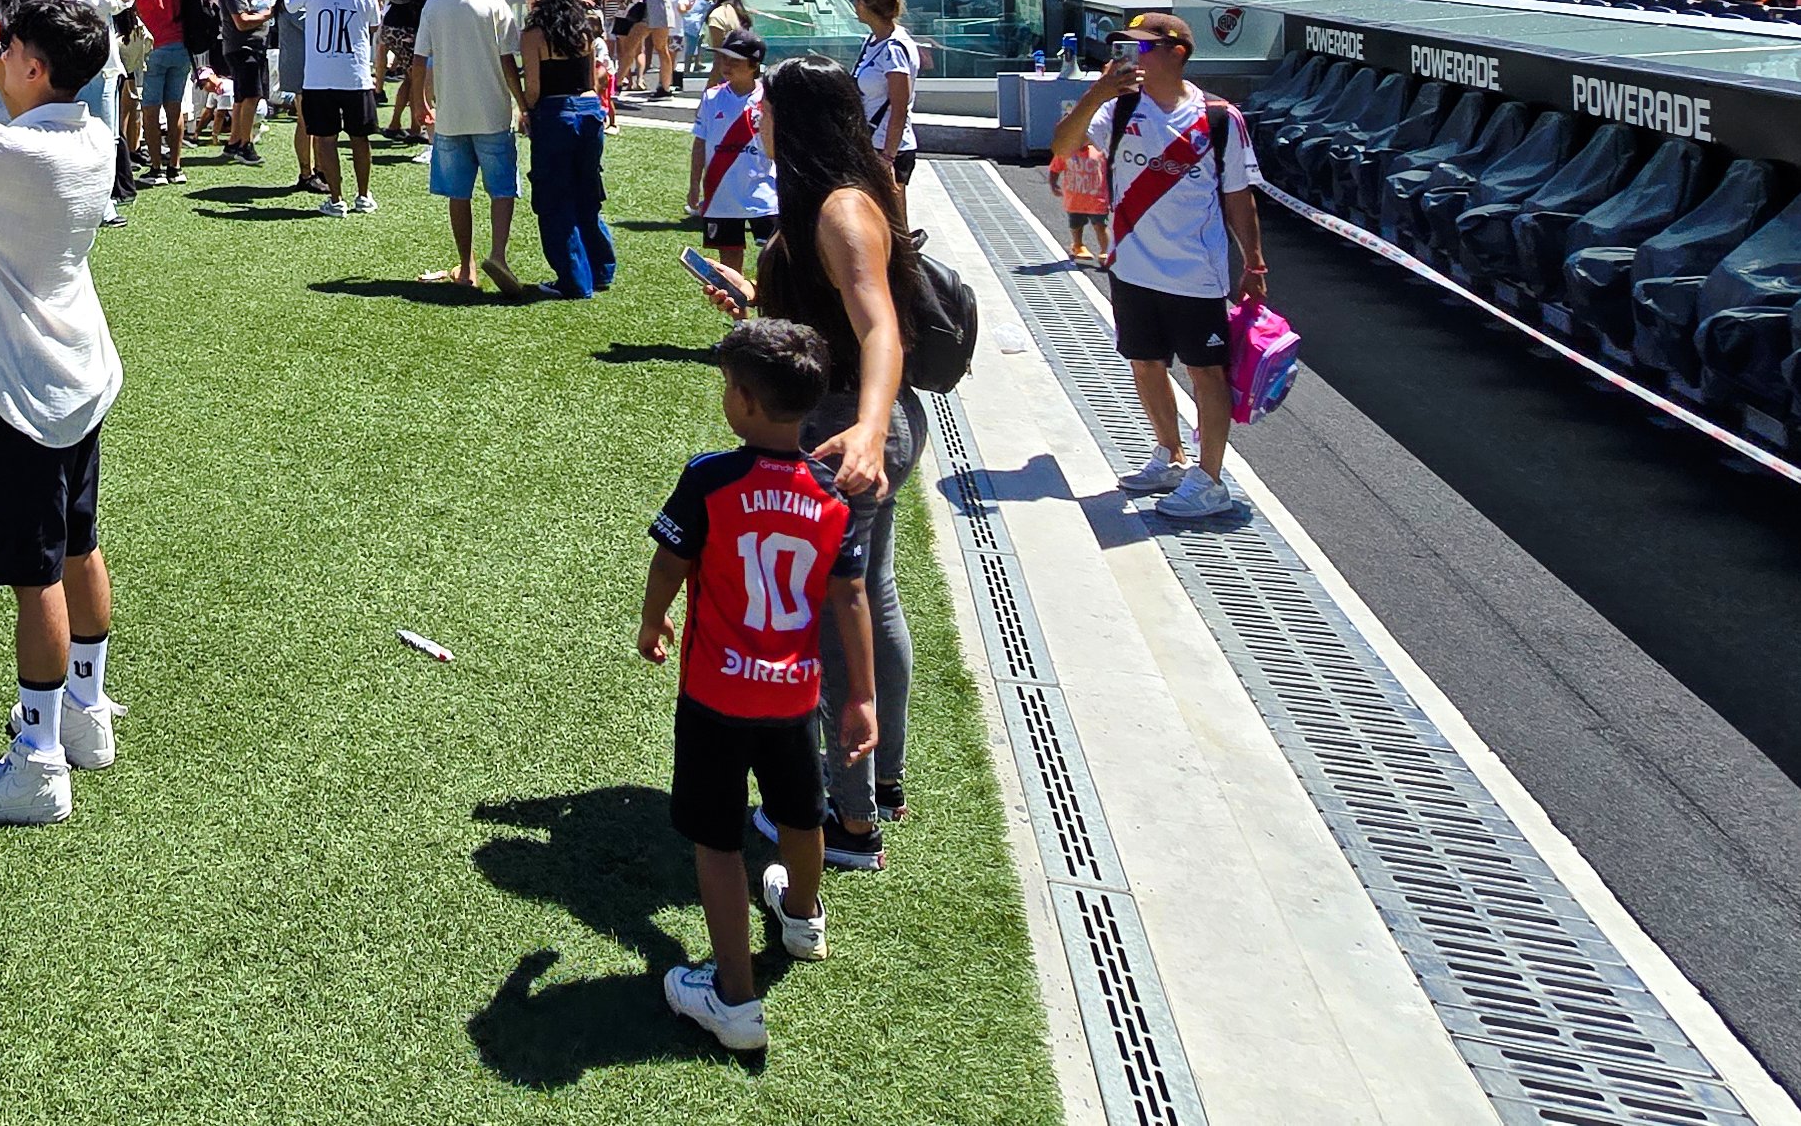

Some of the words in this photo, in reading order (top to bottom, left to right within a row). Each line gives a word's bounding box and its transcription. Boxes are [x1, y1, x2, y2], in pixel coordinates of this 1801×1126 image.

[1306, 25, 1365, 61] POWERADE
[1411, 44, 1501, 91] POWERADE
[1572, 74, 1712, 142] POWERADE
[1123, 150, 1202, 179] codere
[741, 489, 822, 523] LANZINI
[737, 532, 818, 632] 10
